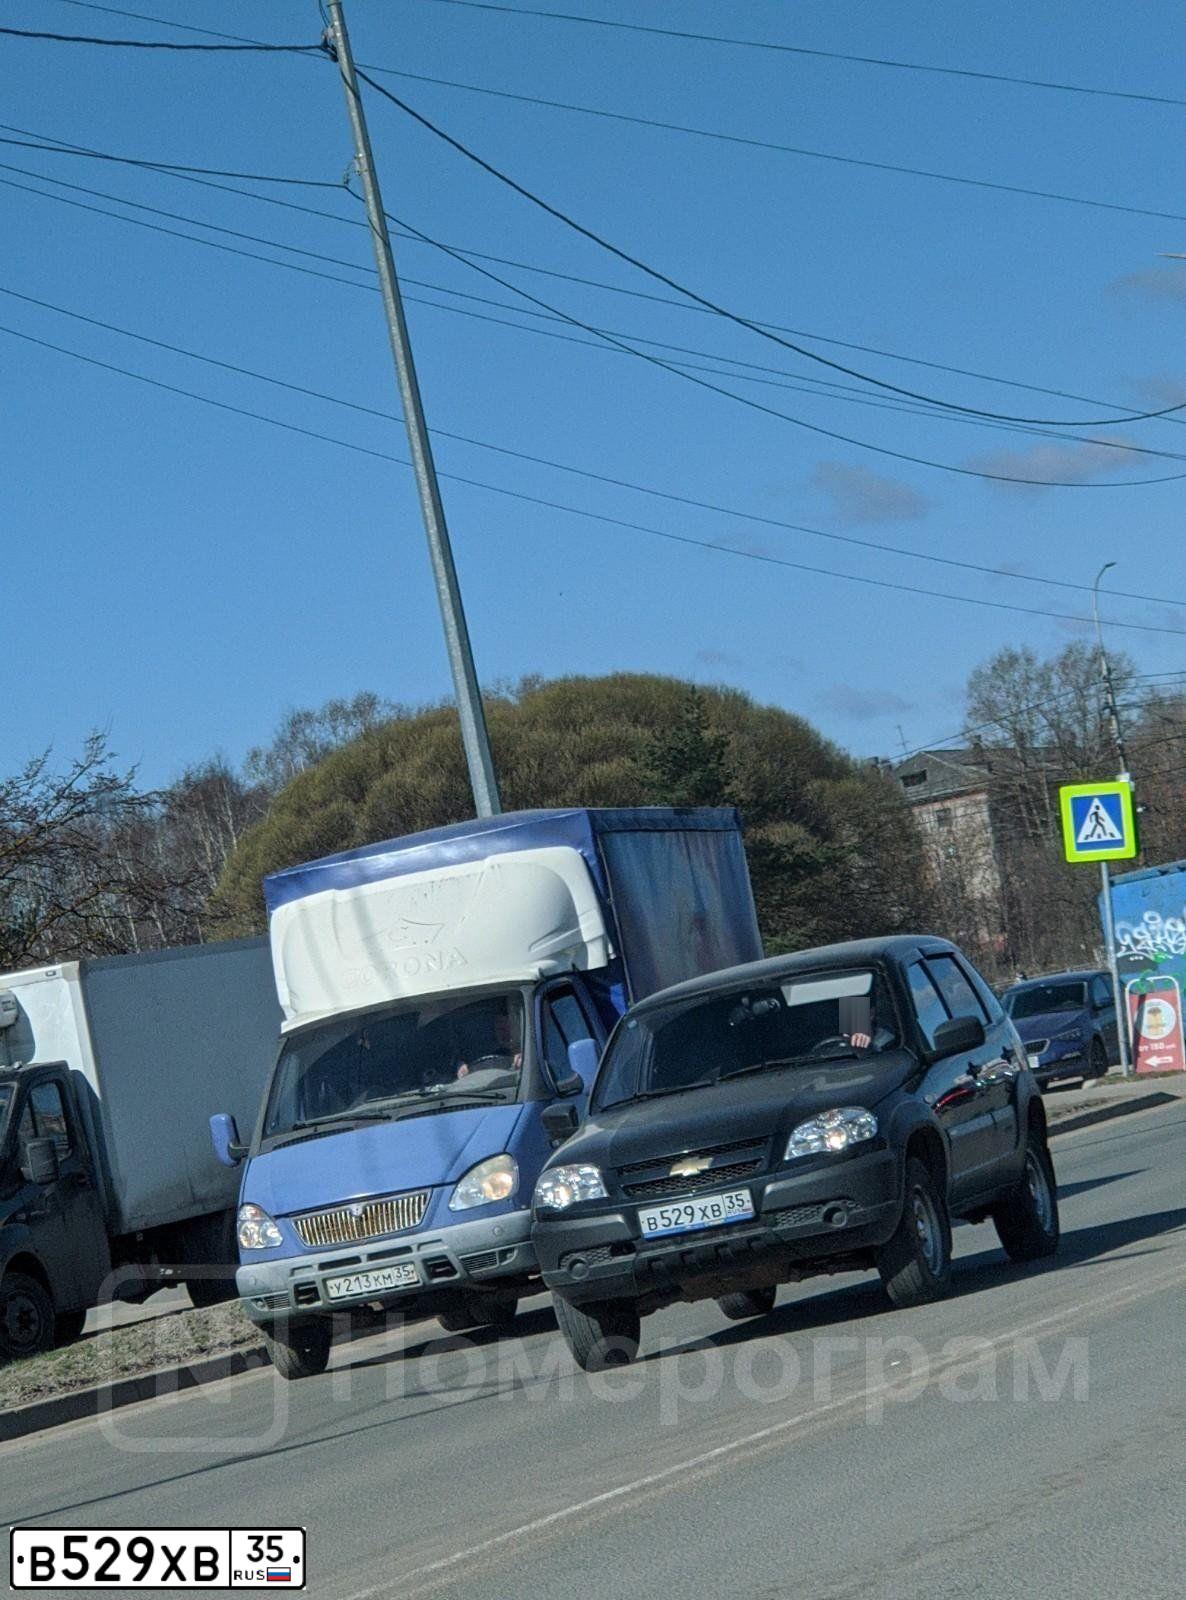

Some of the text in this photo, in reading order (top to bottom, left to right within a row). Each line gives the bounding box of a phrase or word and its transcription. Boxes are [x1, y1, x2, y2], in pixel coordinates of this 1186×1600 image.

[646, 1193, 745, 1231] В529ХВ 35
[334, 1265, 410, 1294] У213КМ 35
